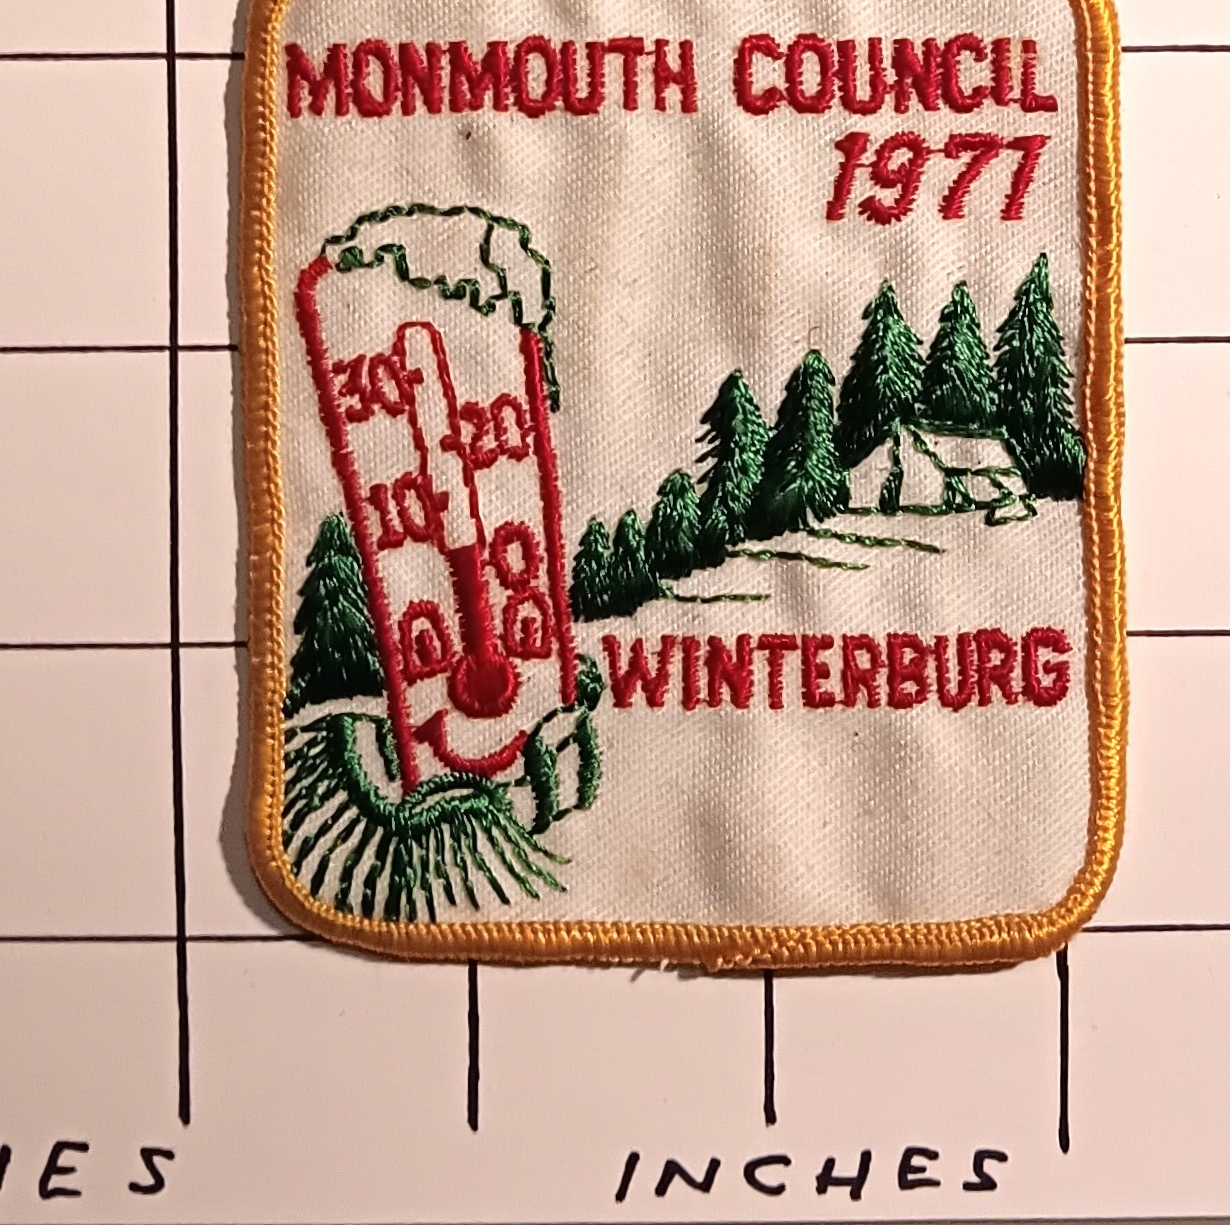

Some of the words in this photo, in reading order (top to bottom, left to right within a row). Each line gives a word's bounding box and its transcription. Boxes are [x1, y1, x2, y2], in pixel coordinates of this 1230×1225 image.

[286, 38, 698, 120] MONMOUTH
[733, 34, 1058, 116] COUNCIL
[825, 130, 1047, 225] 1977
[600, 630, 1070, 710] WINTERBURG
[0, 1140, 175, 1201] ES
[615, 1148, 1009, 1203] INCHES
